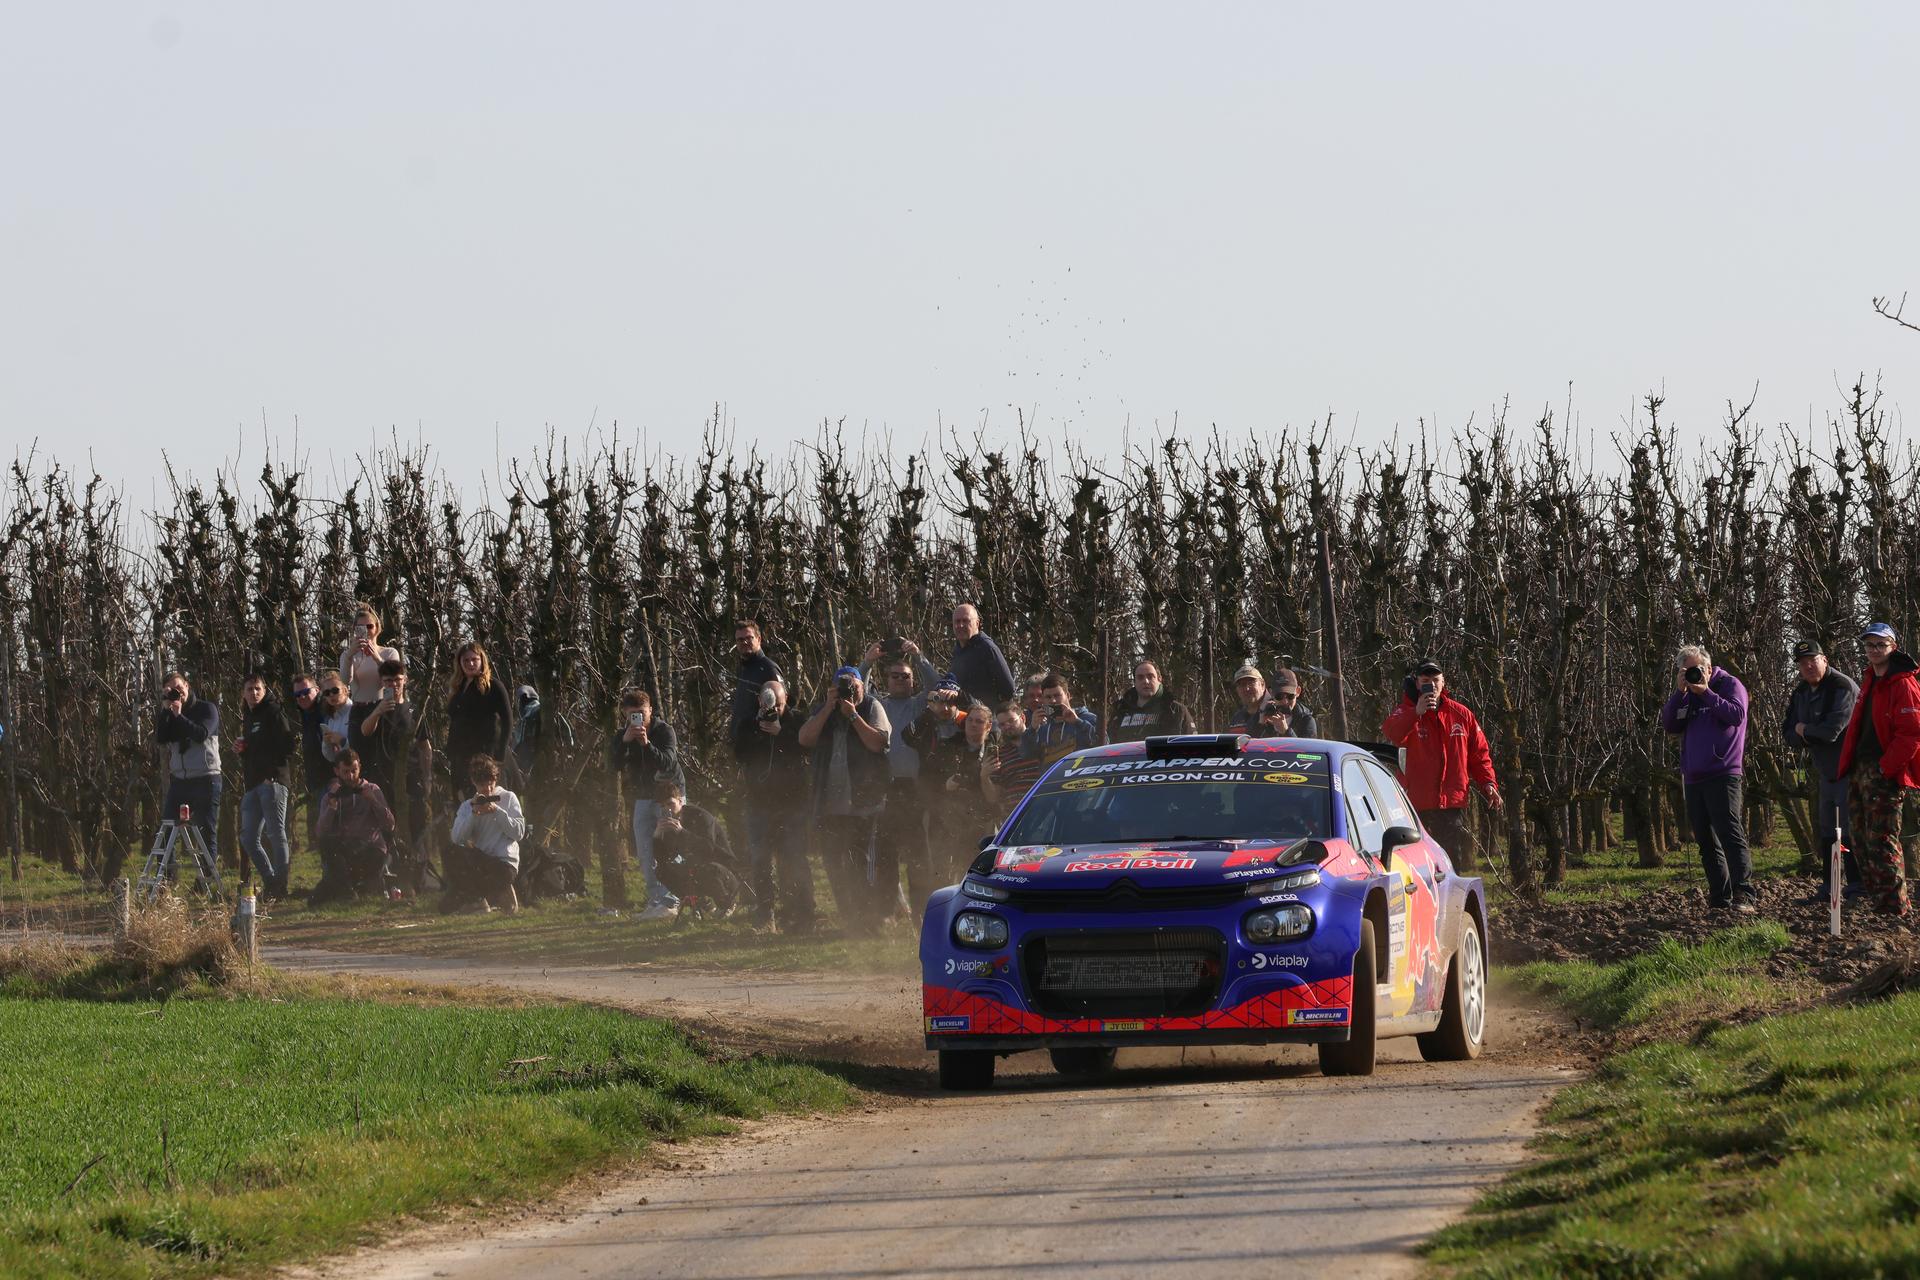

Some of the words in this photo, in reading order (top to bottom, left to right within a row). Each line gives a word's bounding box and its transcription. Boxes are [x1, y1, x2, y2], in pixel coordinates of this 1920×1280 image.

[1063, 757, 1313, 778] VERSTAPPEN.COM
[1121, 772, 1246, 784] KROON-OIL
[1064, 860, 1132, 873] Red
[1131, 858, 1197, 870] Bull
[1259, 893, 1299, 904] sparco
[956, 959, 988, 973] viaplay
[1269, 954, 1309, 968] viaplay
